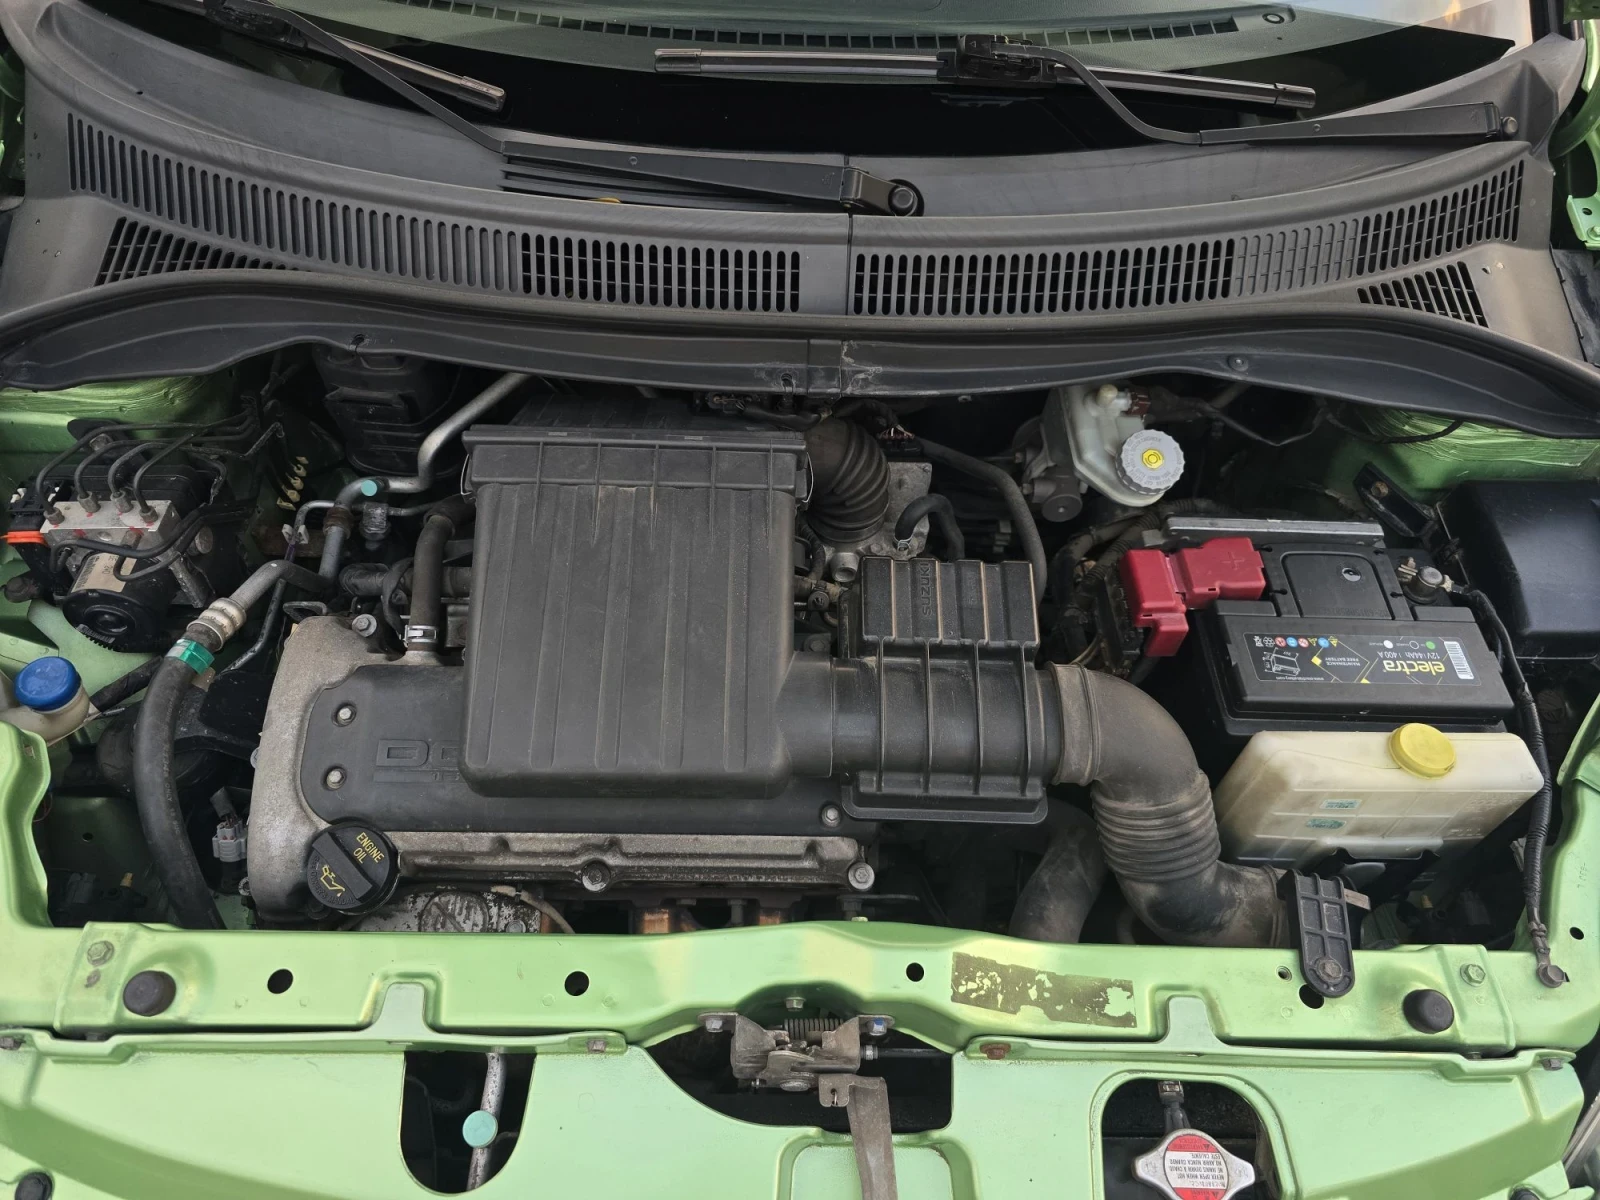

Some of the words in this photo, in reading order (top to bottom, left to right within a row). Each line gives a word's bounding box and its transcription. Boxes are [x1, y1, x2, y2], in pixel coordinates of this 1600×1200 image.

[919, 561, 932, 616] SUZUKI
[1385, 651, 1398, 659] 400
[1383, 660, 1445, 676] electra
[353, 847, 367, 864] OIL
[356, 832, 385, 863] ENGINE
